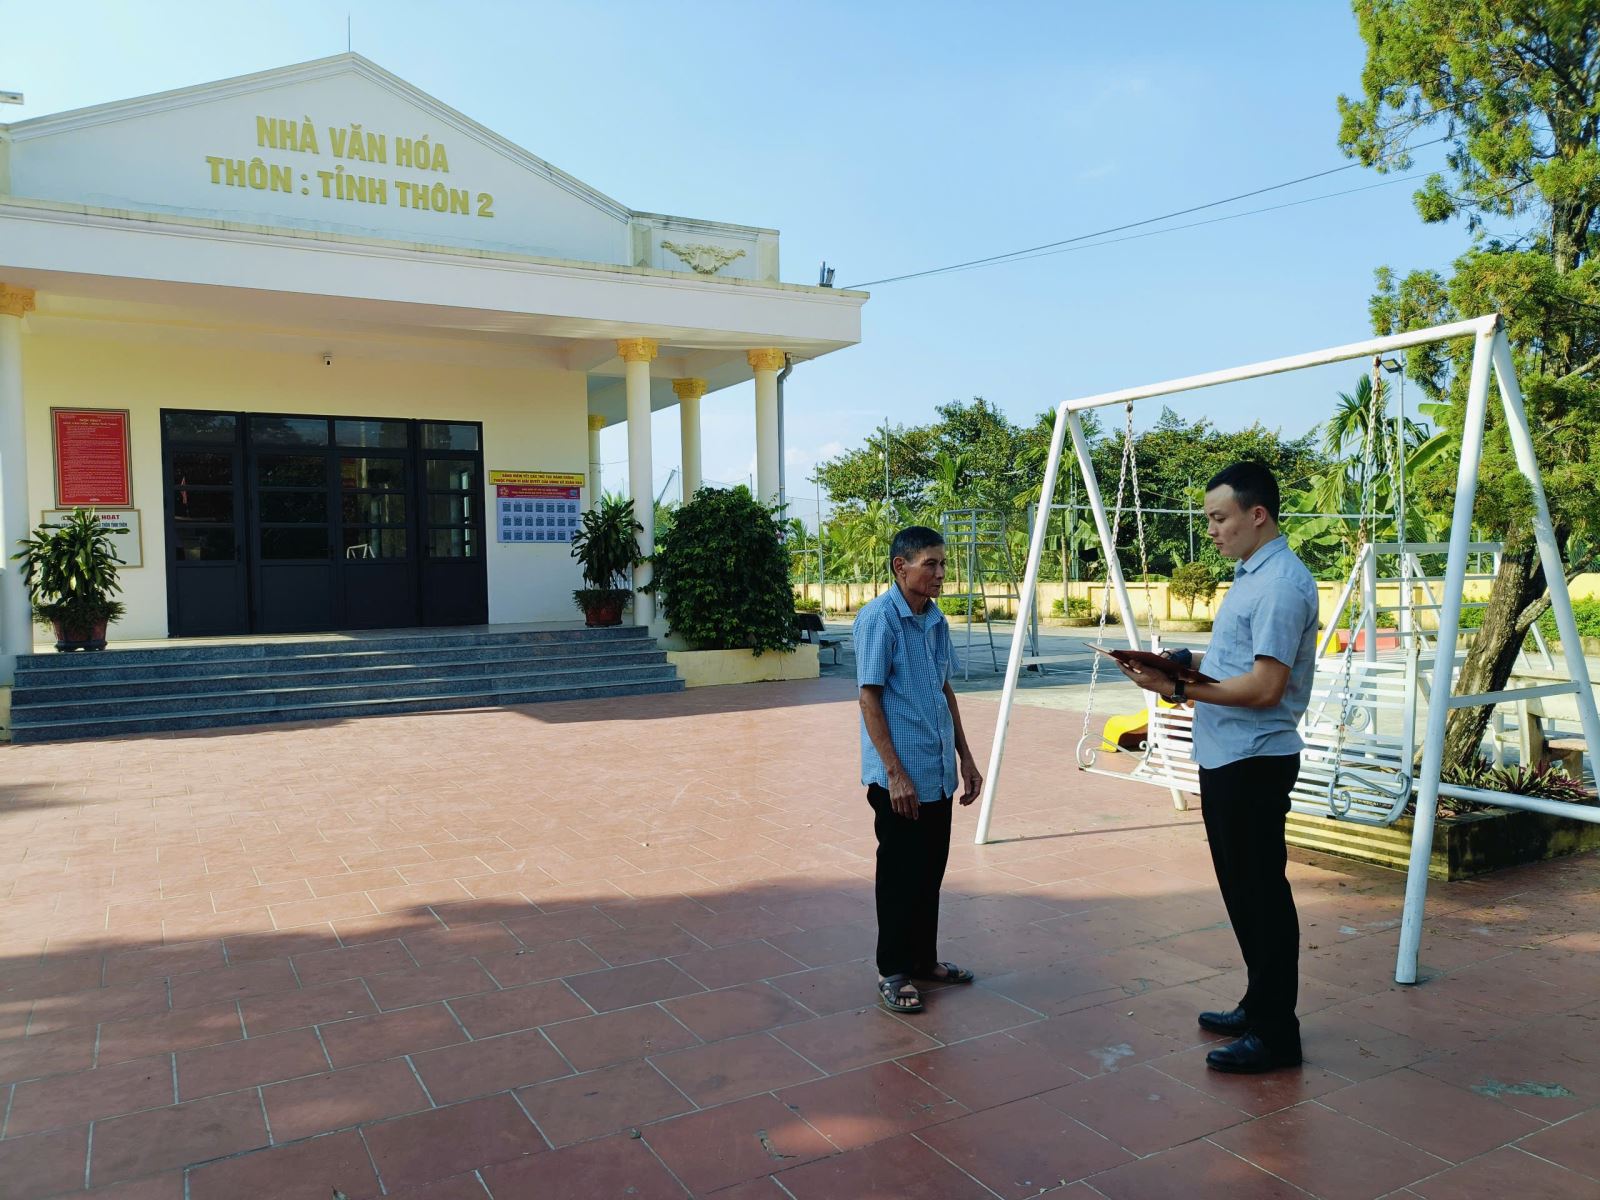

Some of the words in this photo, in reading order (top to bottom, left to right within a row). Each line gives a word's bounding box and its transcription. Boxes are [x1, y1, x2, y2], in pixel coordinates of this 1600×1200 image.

[256, 115, 320, 155] NHÀ
[328, 123, 387, 164] VĂN
[395, 134, 450, 173] HÓA
[205, 155, 293, 194] THÔN
[395, 181, 470, 216] THÔN
[477, 192, 494, 218] 2
